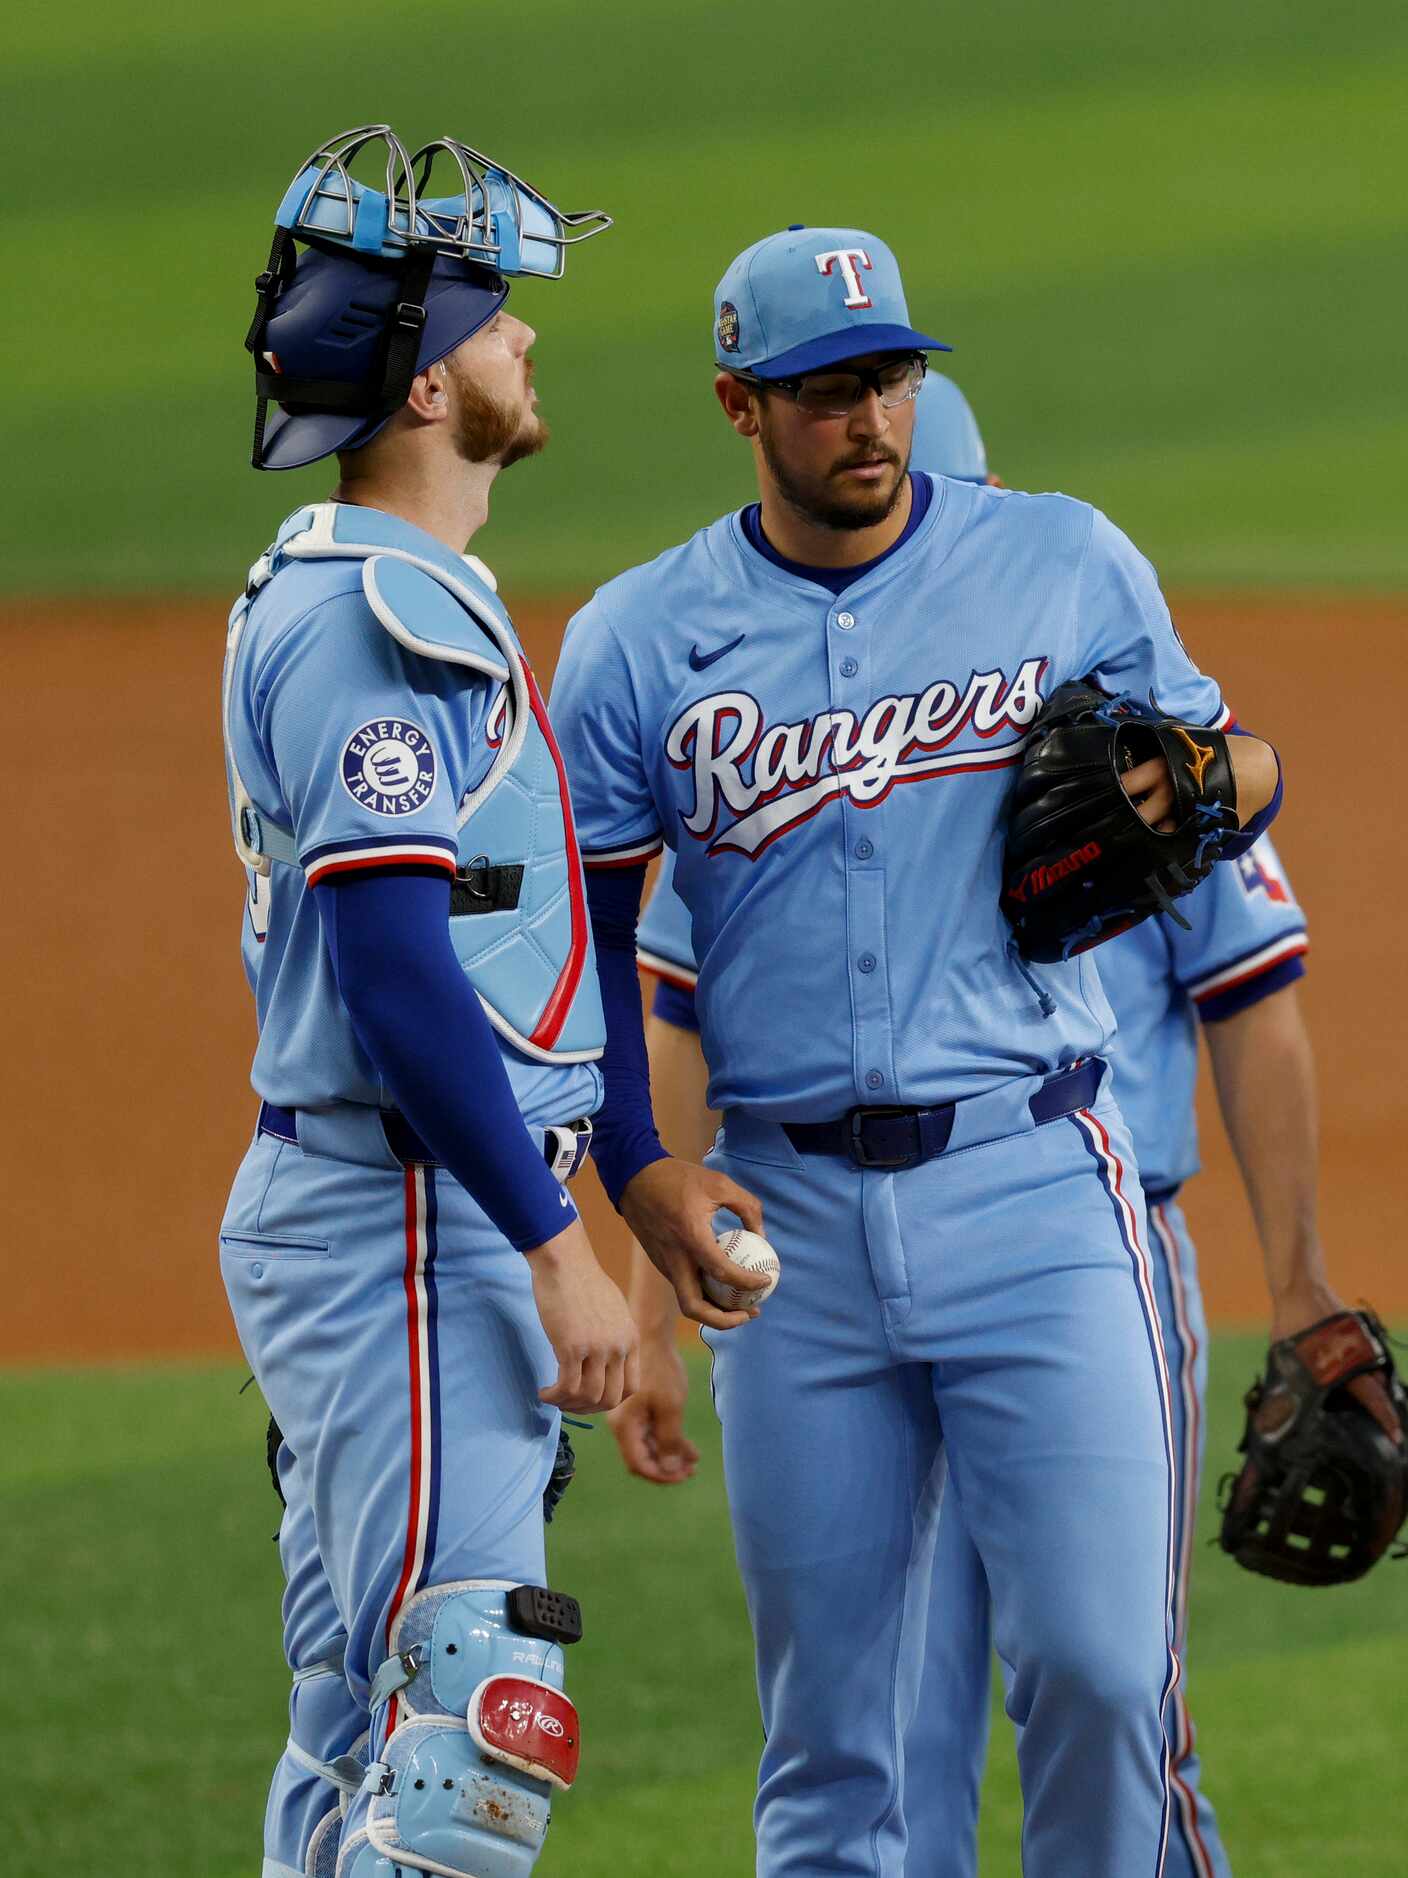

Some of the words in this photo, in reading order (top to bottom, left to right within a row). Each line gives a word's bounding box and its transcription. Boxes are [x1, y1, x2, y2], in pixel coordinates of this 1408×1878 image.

[814, 248, 873, 310] T
[349, 722, 431, 757] ENERGY
[664, 656, 1049, 848] Rangers
[347, 771, 433, 814] TRANSFER
[1030, 841, 1102, 895] Mizuno
